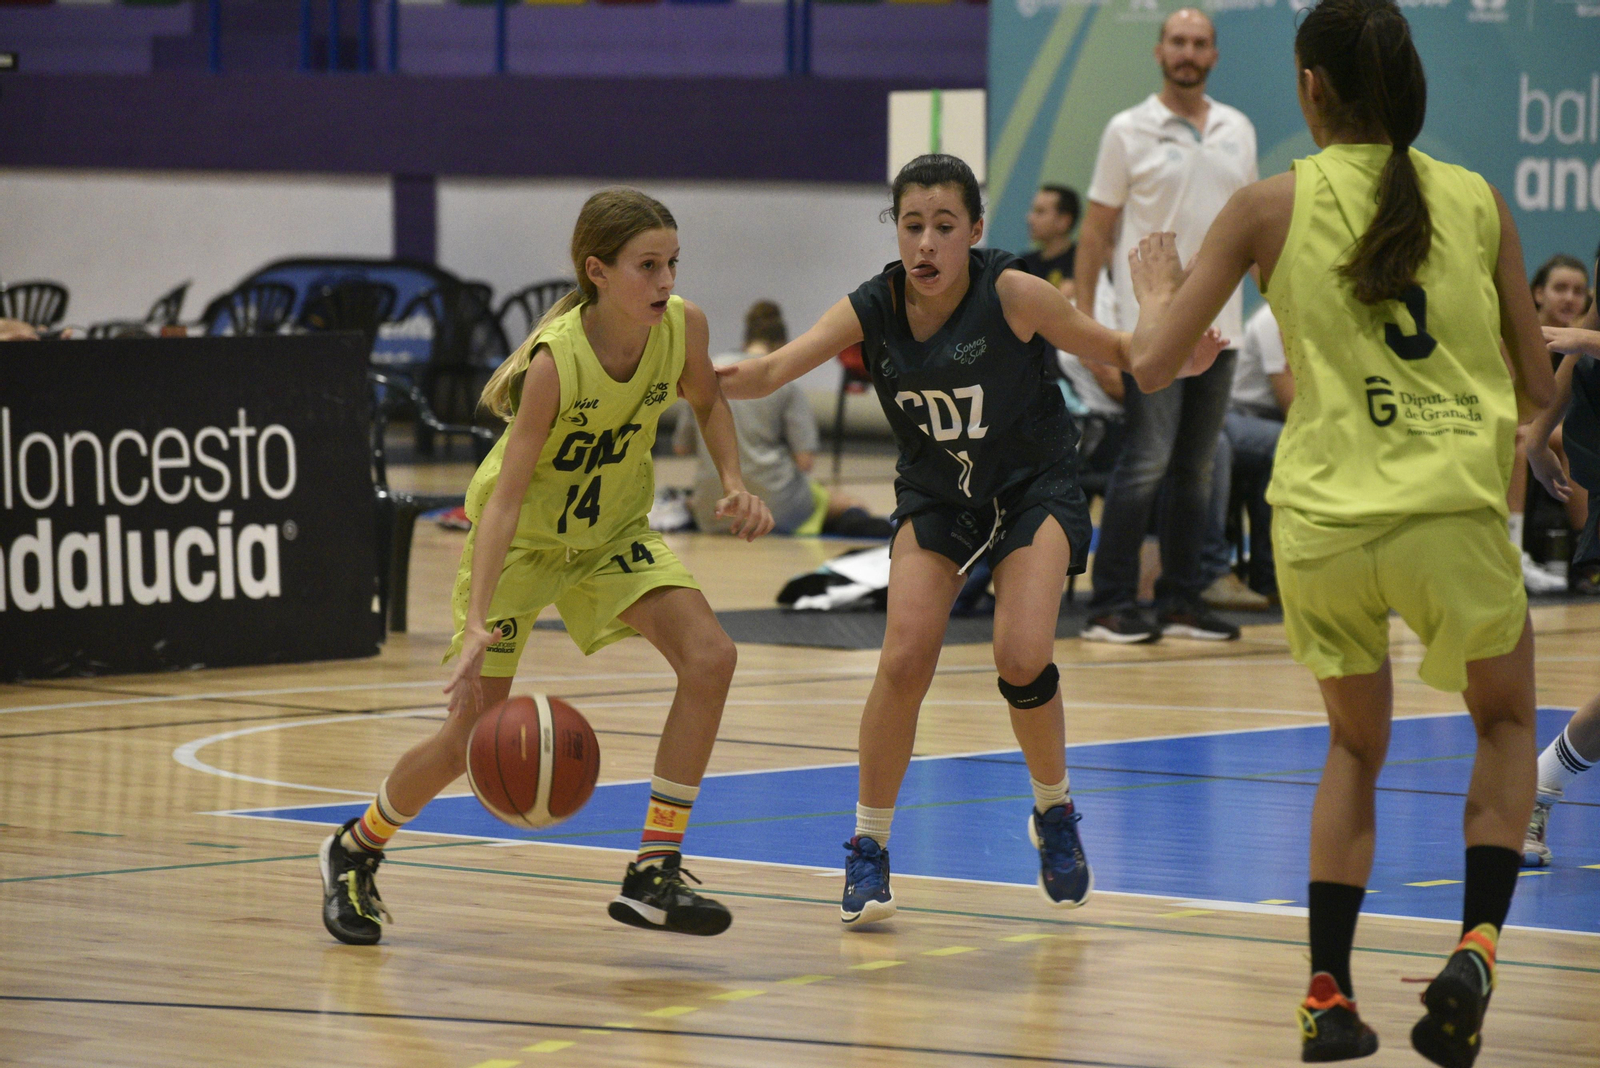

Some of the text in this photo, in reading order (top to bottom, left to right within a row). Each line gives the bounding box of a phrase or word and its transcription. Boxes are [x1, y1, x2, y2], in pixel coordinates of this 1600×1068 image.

[1514, 157, 1600, 212] an
[1421, 408, 1483, 421] Granada
[2, 406, 297, 510] loncesto
[557, 475, 602, 534] 14
[0, 510, 281, 613] dalucía
[610, 541, 655, 573] 14
